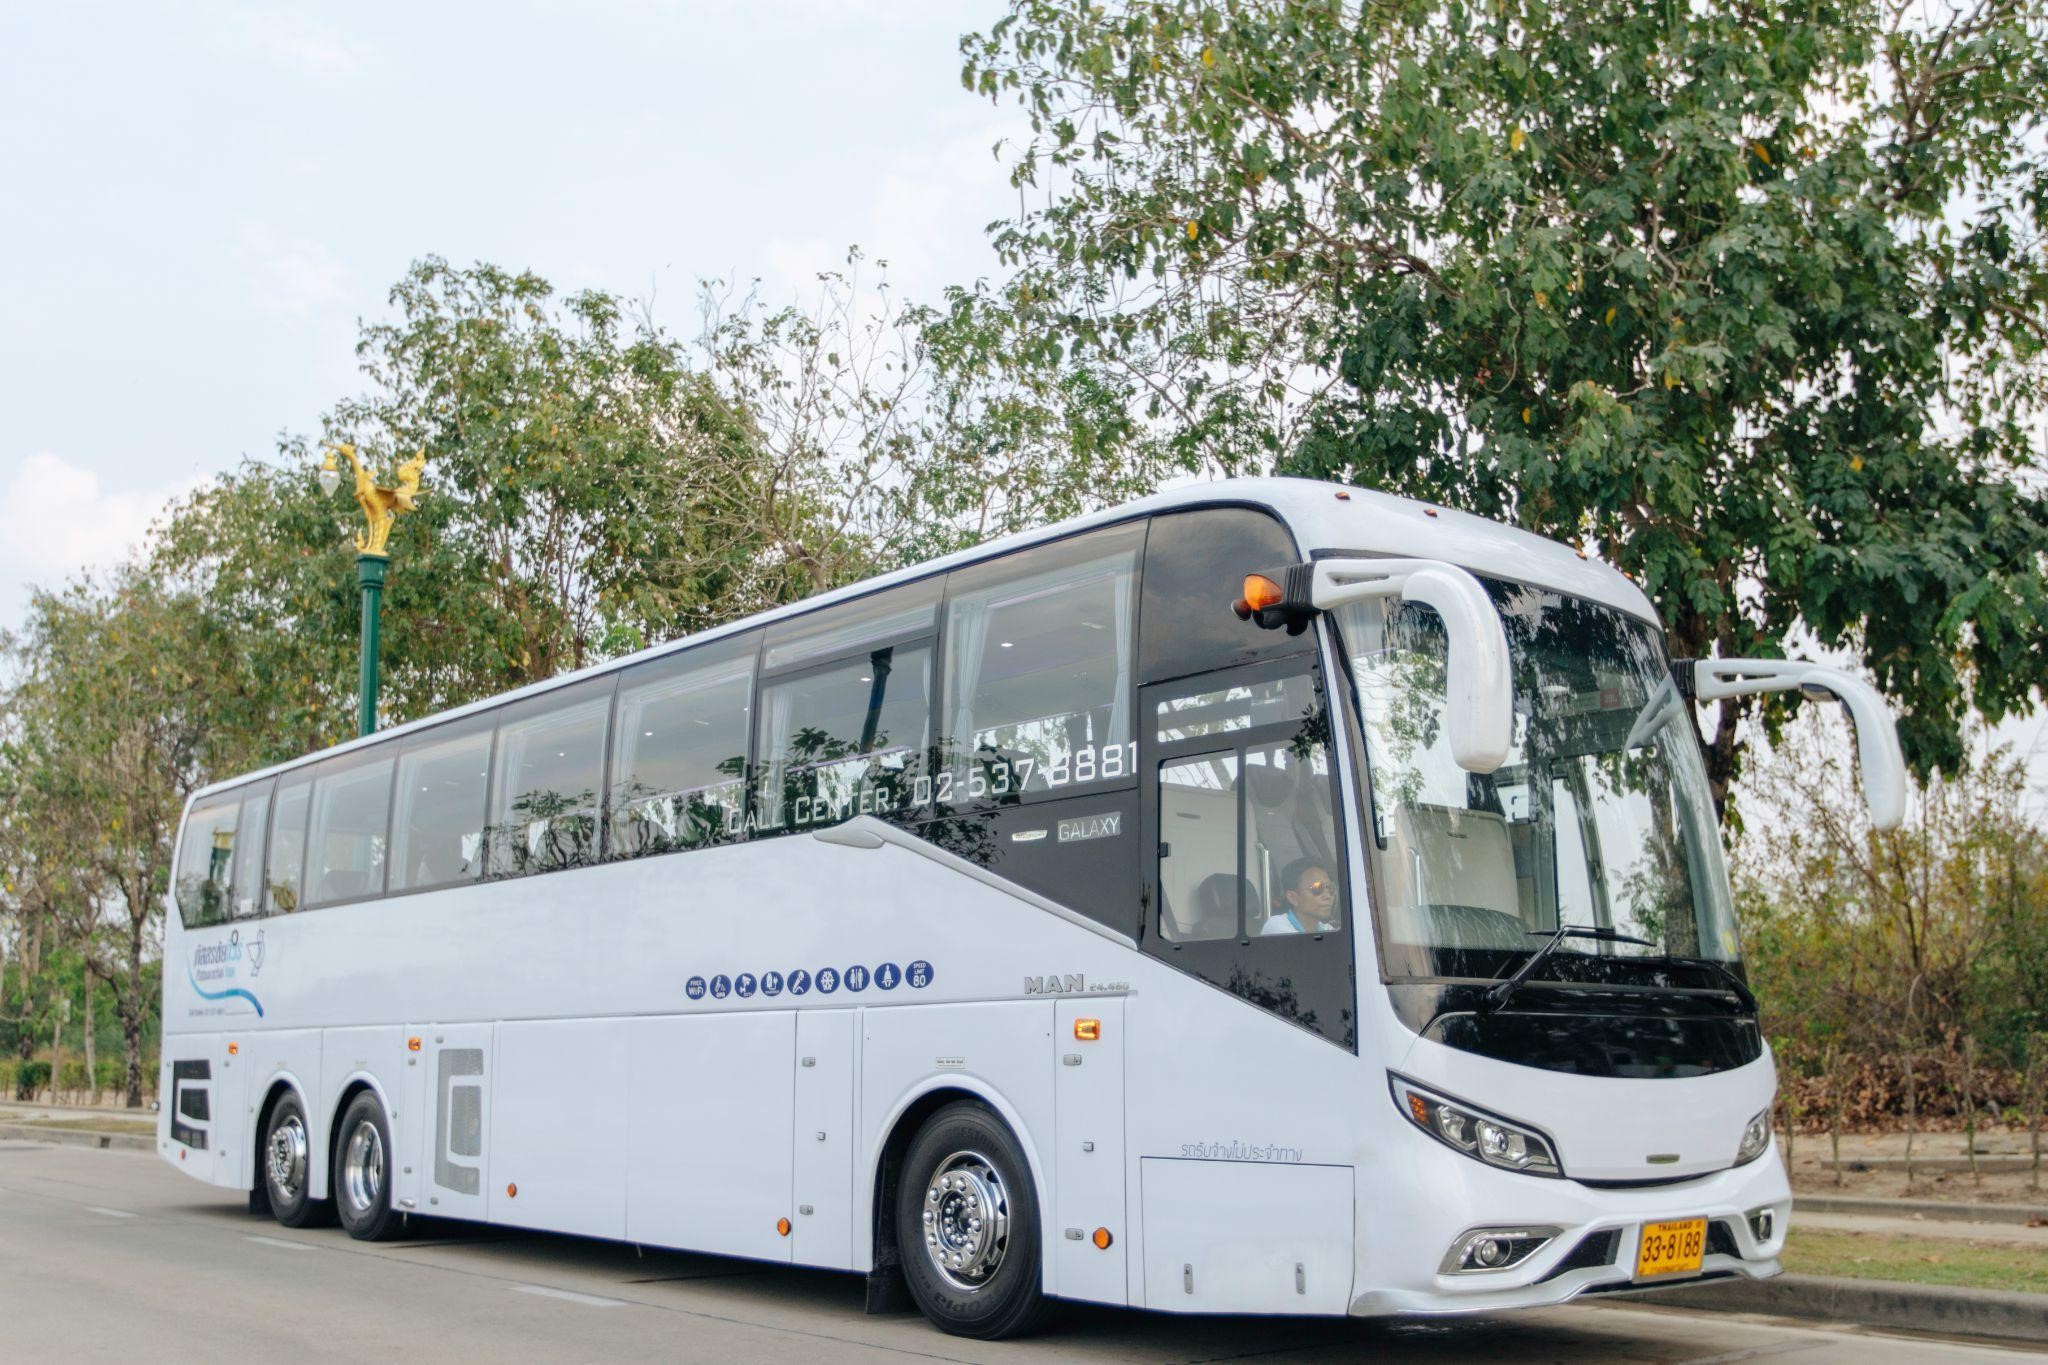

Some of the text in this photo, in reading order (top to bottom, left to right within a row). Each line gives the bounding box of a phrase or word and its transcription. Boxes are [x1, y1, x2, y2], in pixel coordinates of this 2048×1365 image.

[728, 802, 784, 834] CALL
[914, 741, 1137, 805] 02-537-8881
[1059, 817, 1119, 841] GALAXY
[913, 974, 926, 987] 80
[1024, 974, 1084, 994] MAN
[1658, 1221, 1693, 1231] THAILAND
[1642, 1231, 1701, 1262] 33-8188
